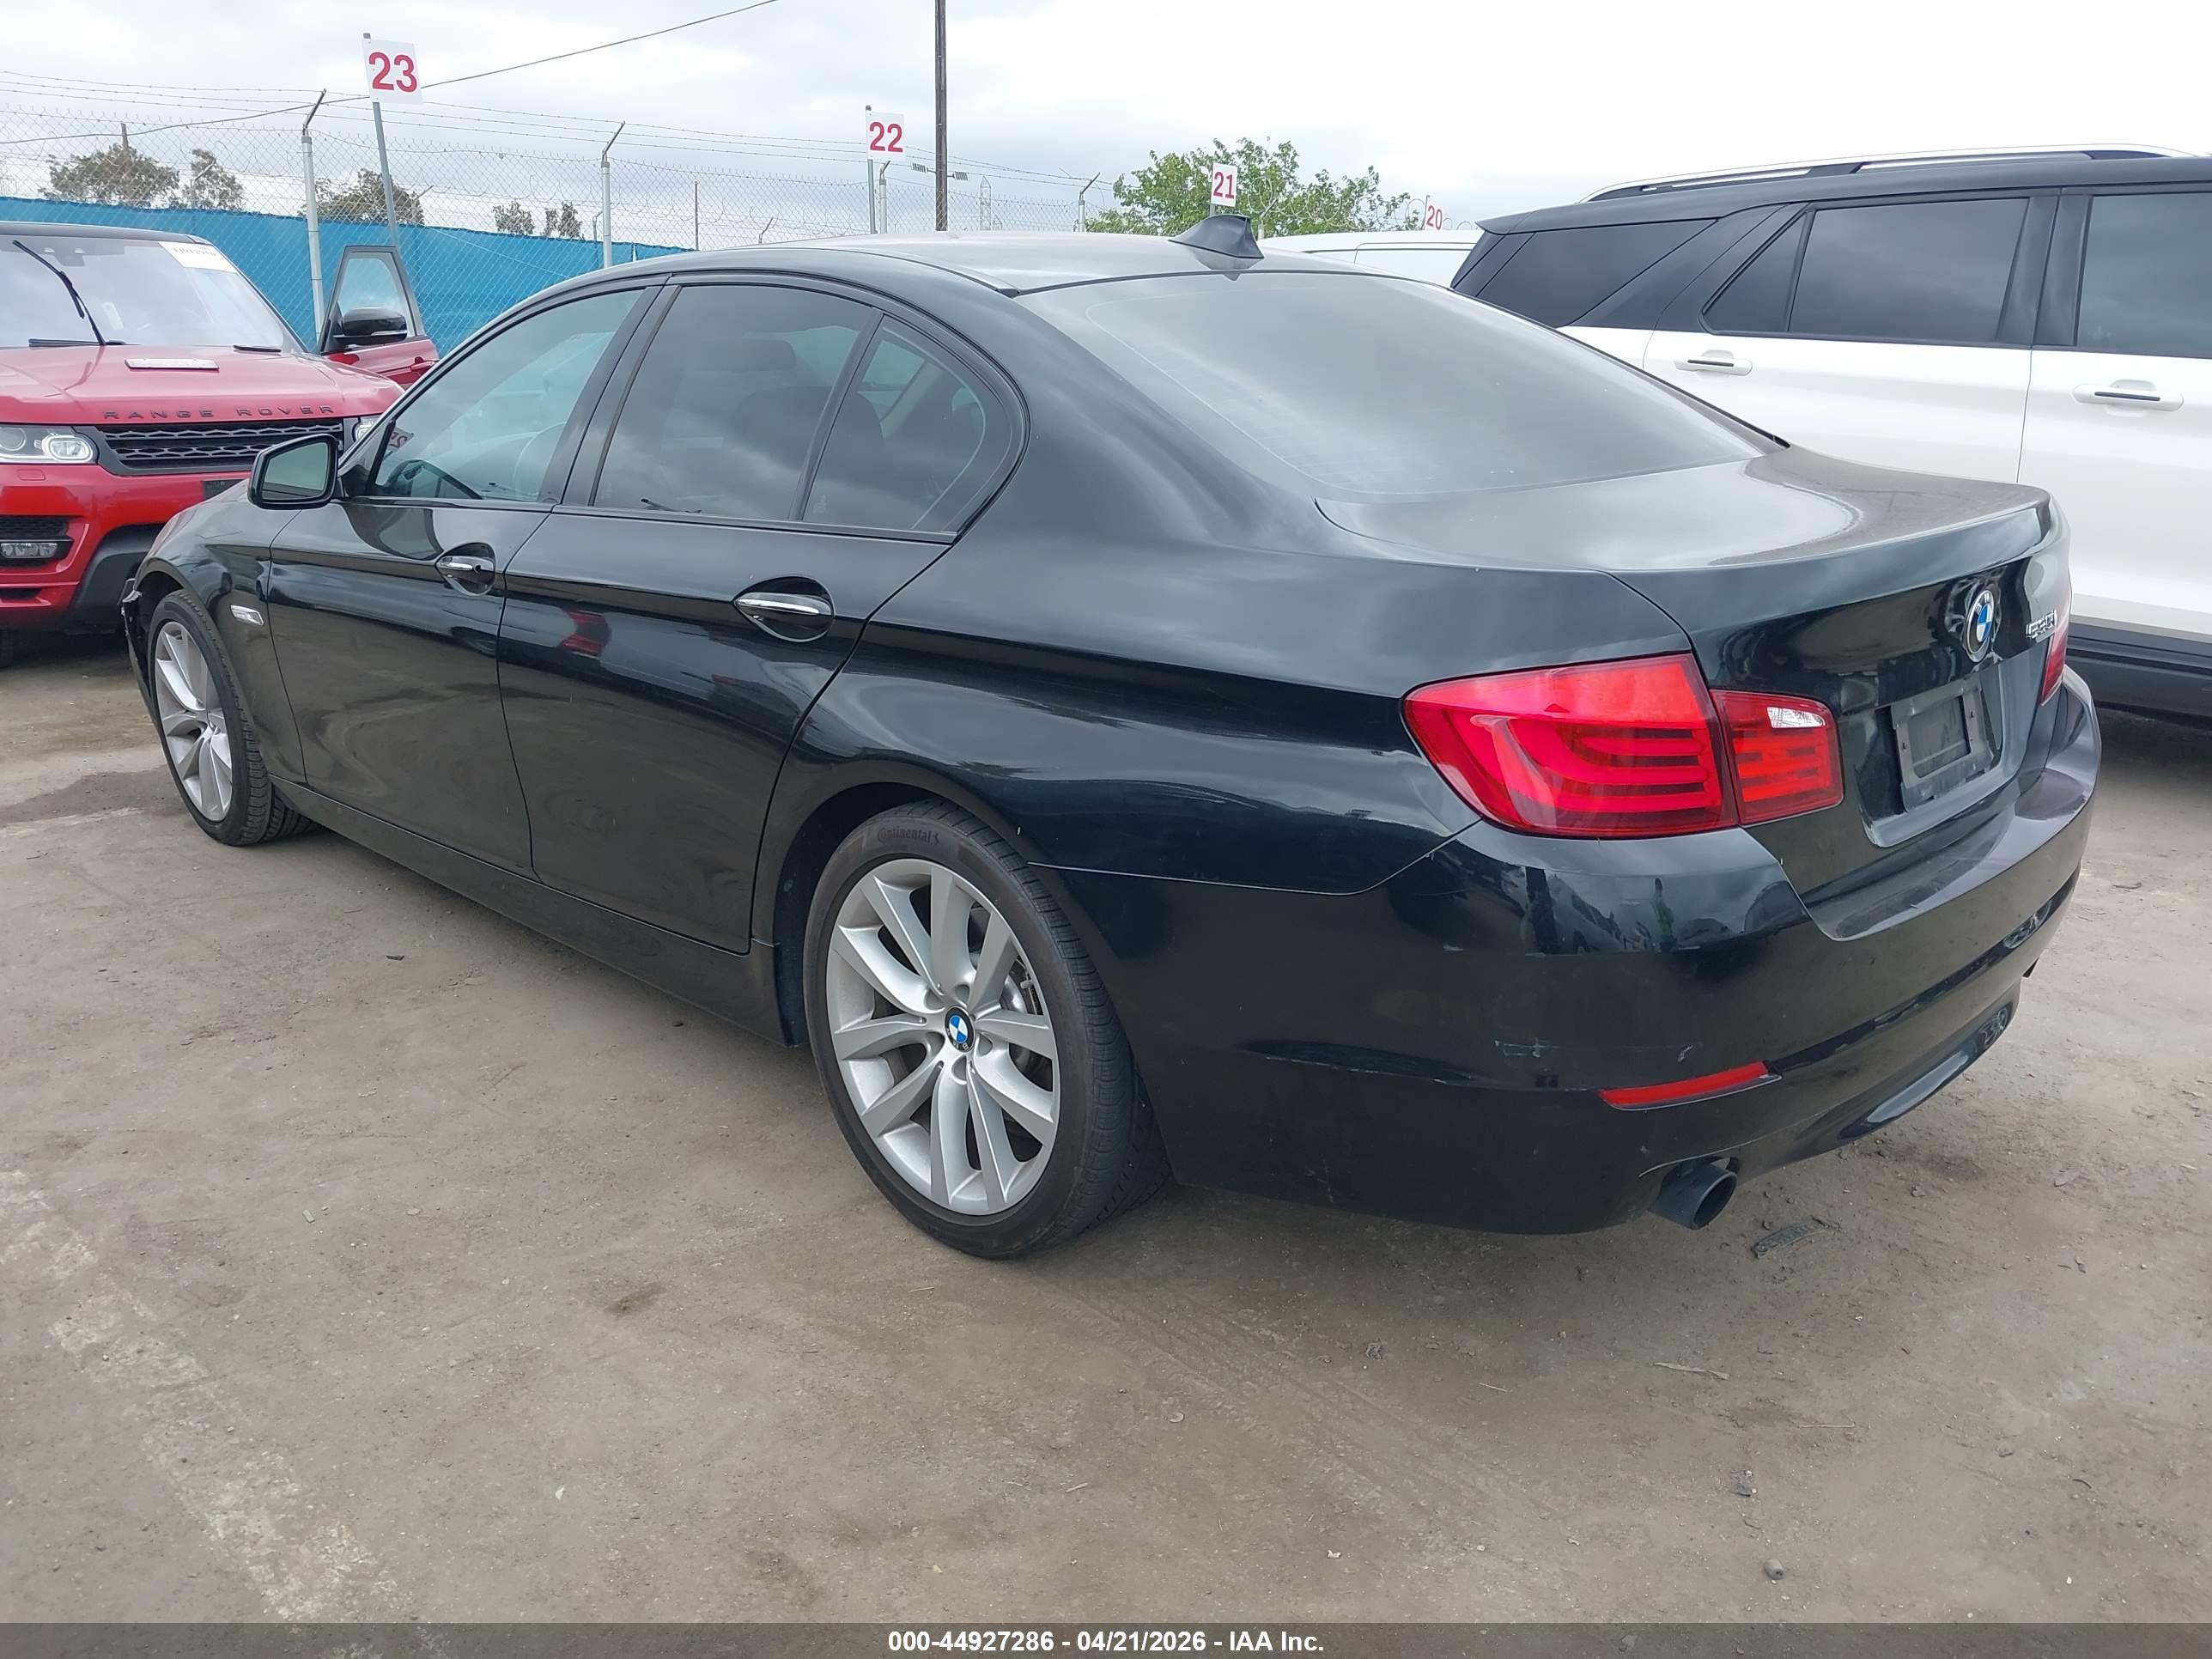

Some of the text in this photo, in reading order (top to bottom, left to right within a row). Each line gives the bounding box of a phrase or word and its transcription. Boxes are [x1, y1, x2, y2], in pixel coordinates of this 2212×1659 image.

[368, 52, 417, 93] 23
[869, 121, 903, 153] 22
[1213, 171, 1234, 199] 21
[1426, 204, 1443, 230] 20
[102, 405, 335, 420] RANGE ROVER
[878, 825, 932, 843] Continental
